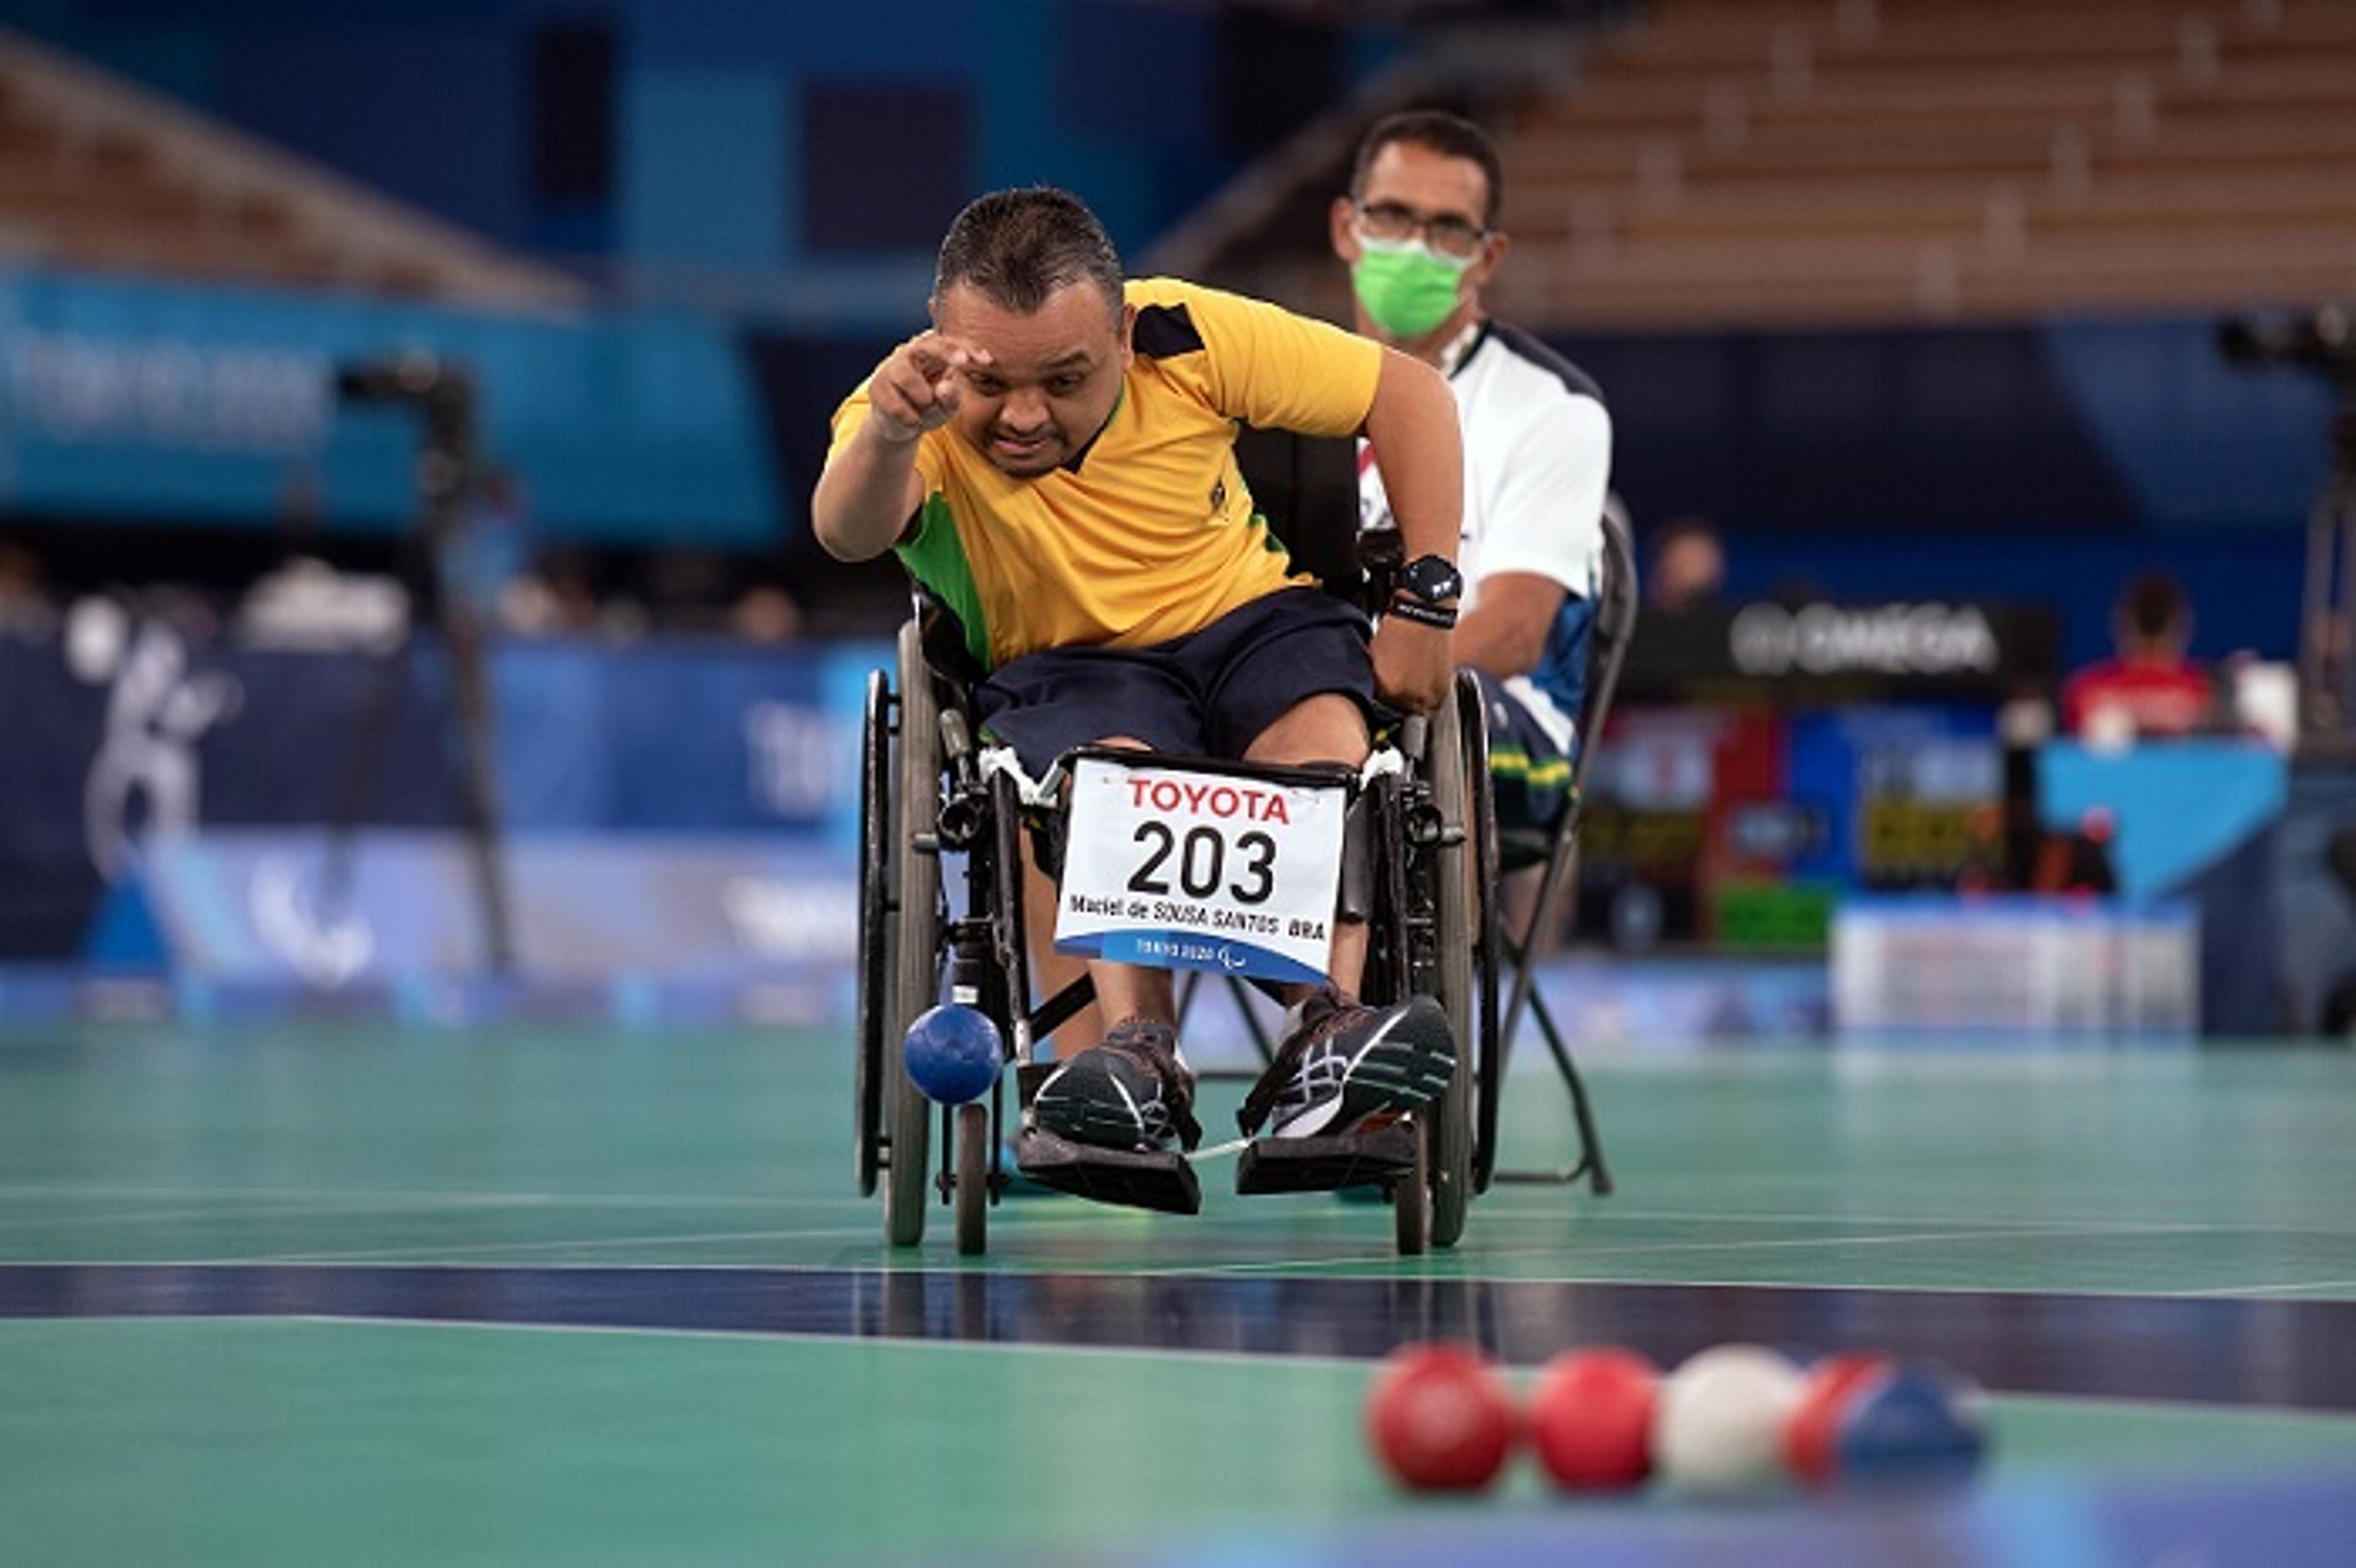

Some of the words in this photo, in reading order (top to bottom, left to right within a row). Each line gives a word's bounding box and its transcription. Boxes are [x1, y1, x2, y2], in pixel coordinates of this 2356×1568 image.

[1128, 779, 1289, 824] TOYOTA
[1127, 821, 1276, 905] 203
[1071, 895, 1123, 917] Maciel
[1128, 900, 1147, 920] de
[1153, 904, 1209, 926] SOUSA
[1214, 910, 1280, 935] SANTOS
[1288, 921, 1325, 941] BRA
[1137, 939, 1179, 957] TOKYO
